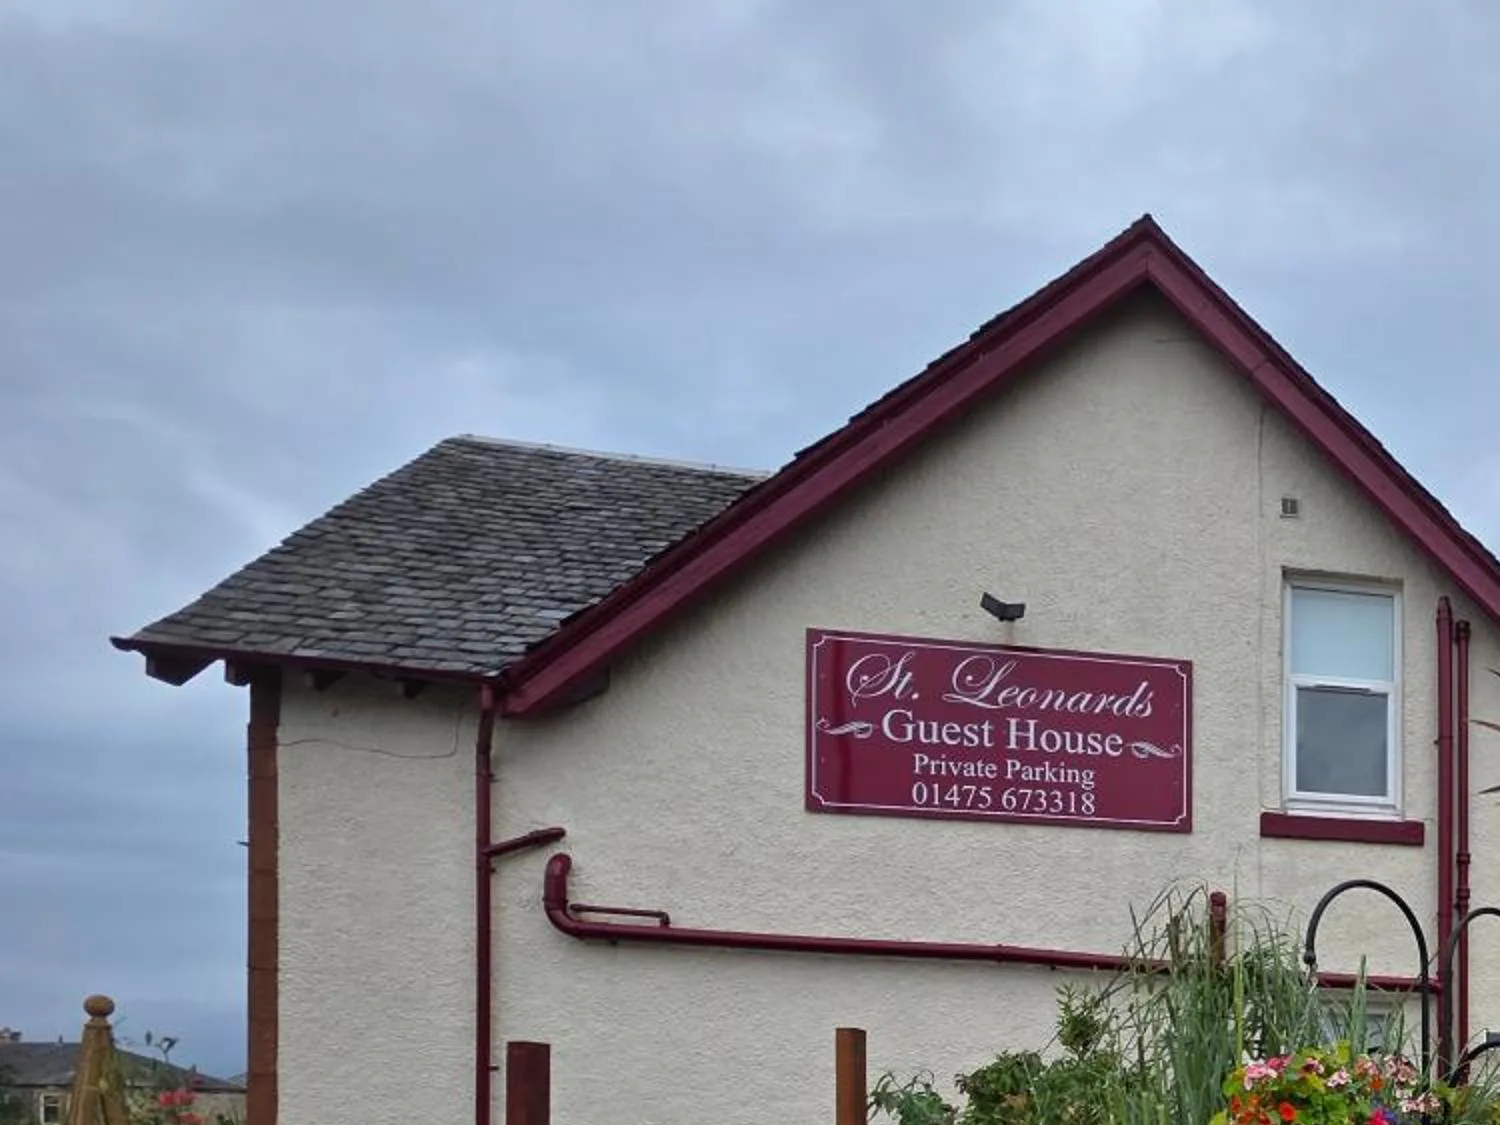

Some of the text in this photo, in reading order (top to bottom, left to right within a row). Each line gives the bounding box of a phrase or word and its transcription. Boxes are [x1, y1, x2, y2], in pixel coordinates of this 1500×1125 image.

[845, 651, 1153, 717] St. Leonards
[882, 709, 1124, 756] Guest House
[913, 754, 1096, 790] Private Parking
[912, 782, 1096, 815] 01475 673318
